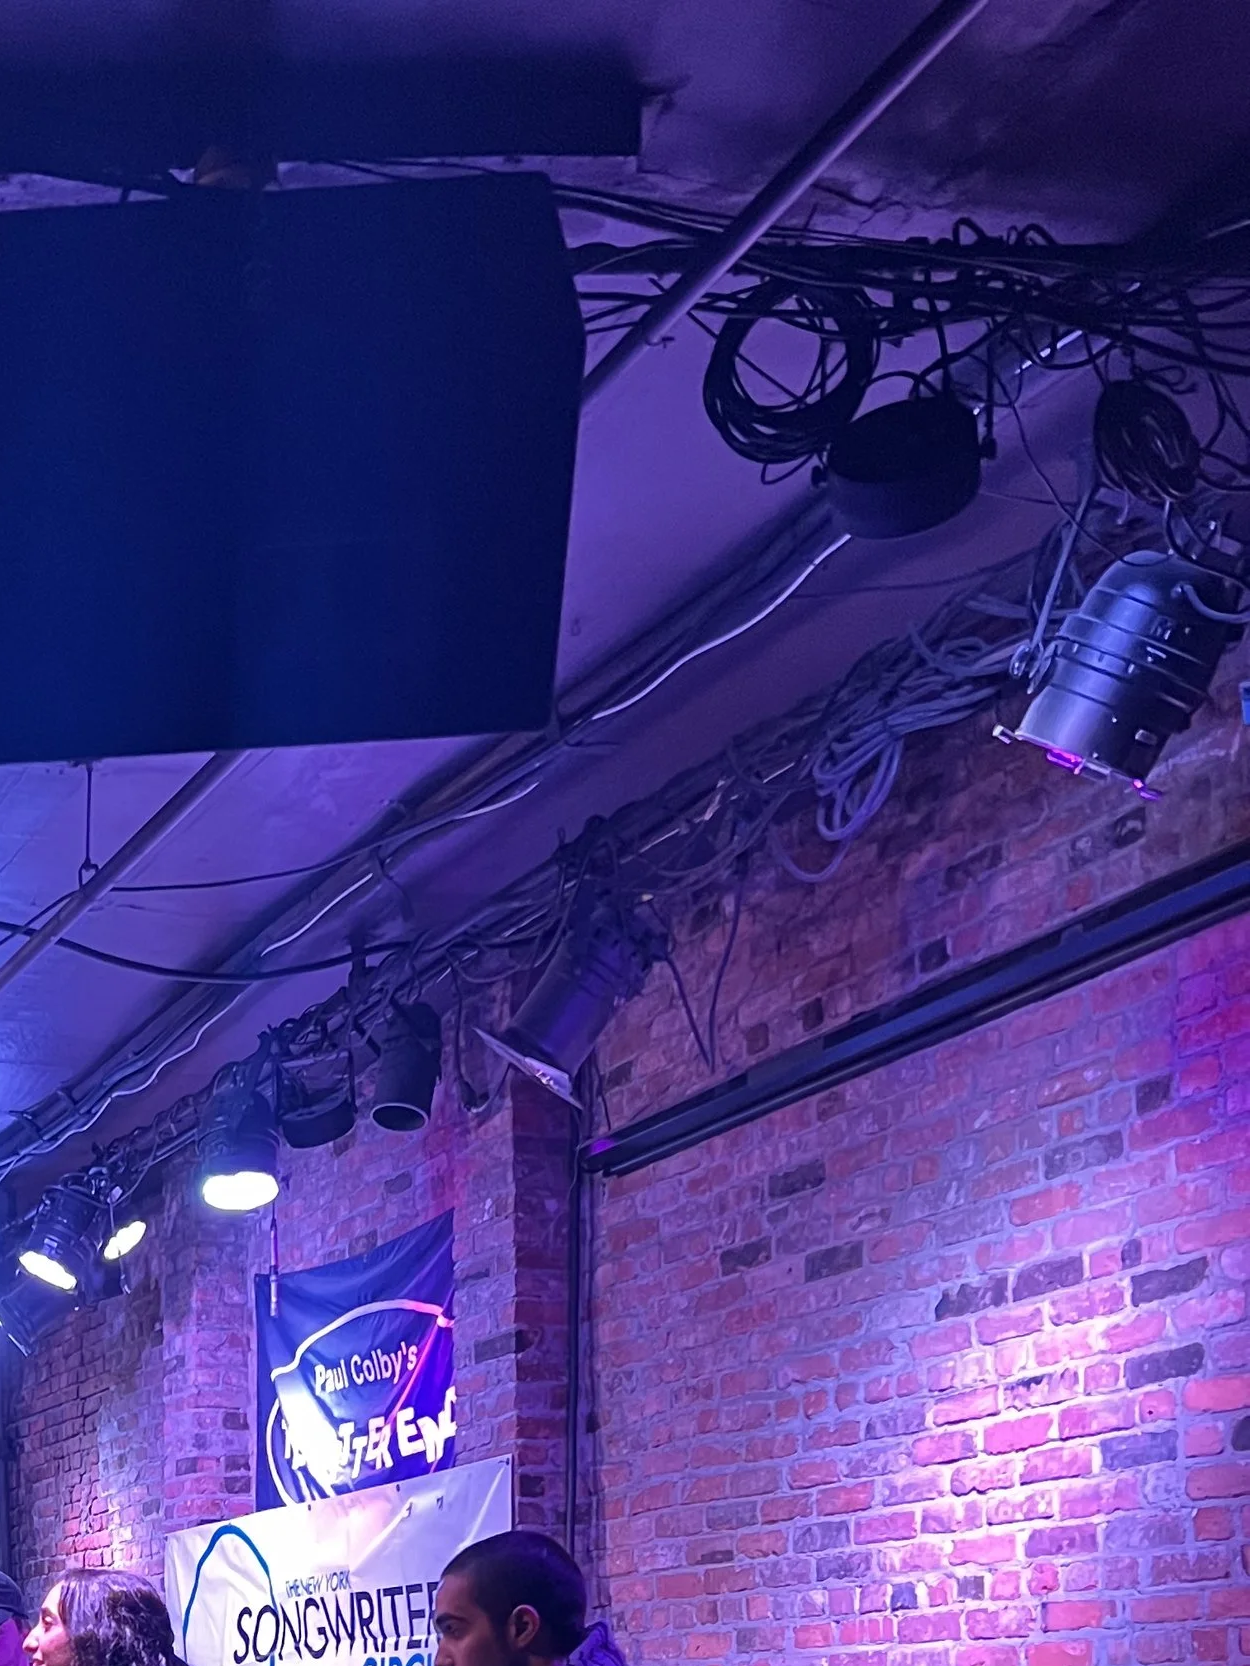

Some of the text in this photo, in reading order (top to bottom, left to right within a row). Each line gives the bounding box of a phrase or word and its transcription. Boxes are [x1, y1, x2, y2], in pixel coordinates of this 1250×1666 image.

[315, 1341, 418, 1396] Paul Colby's
[285, 1569, 351, 1598] THE NEW YORK
